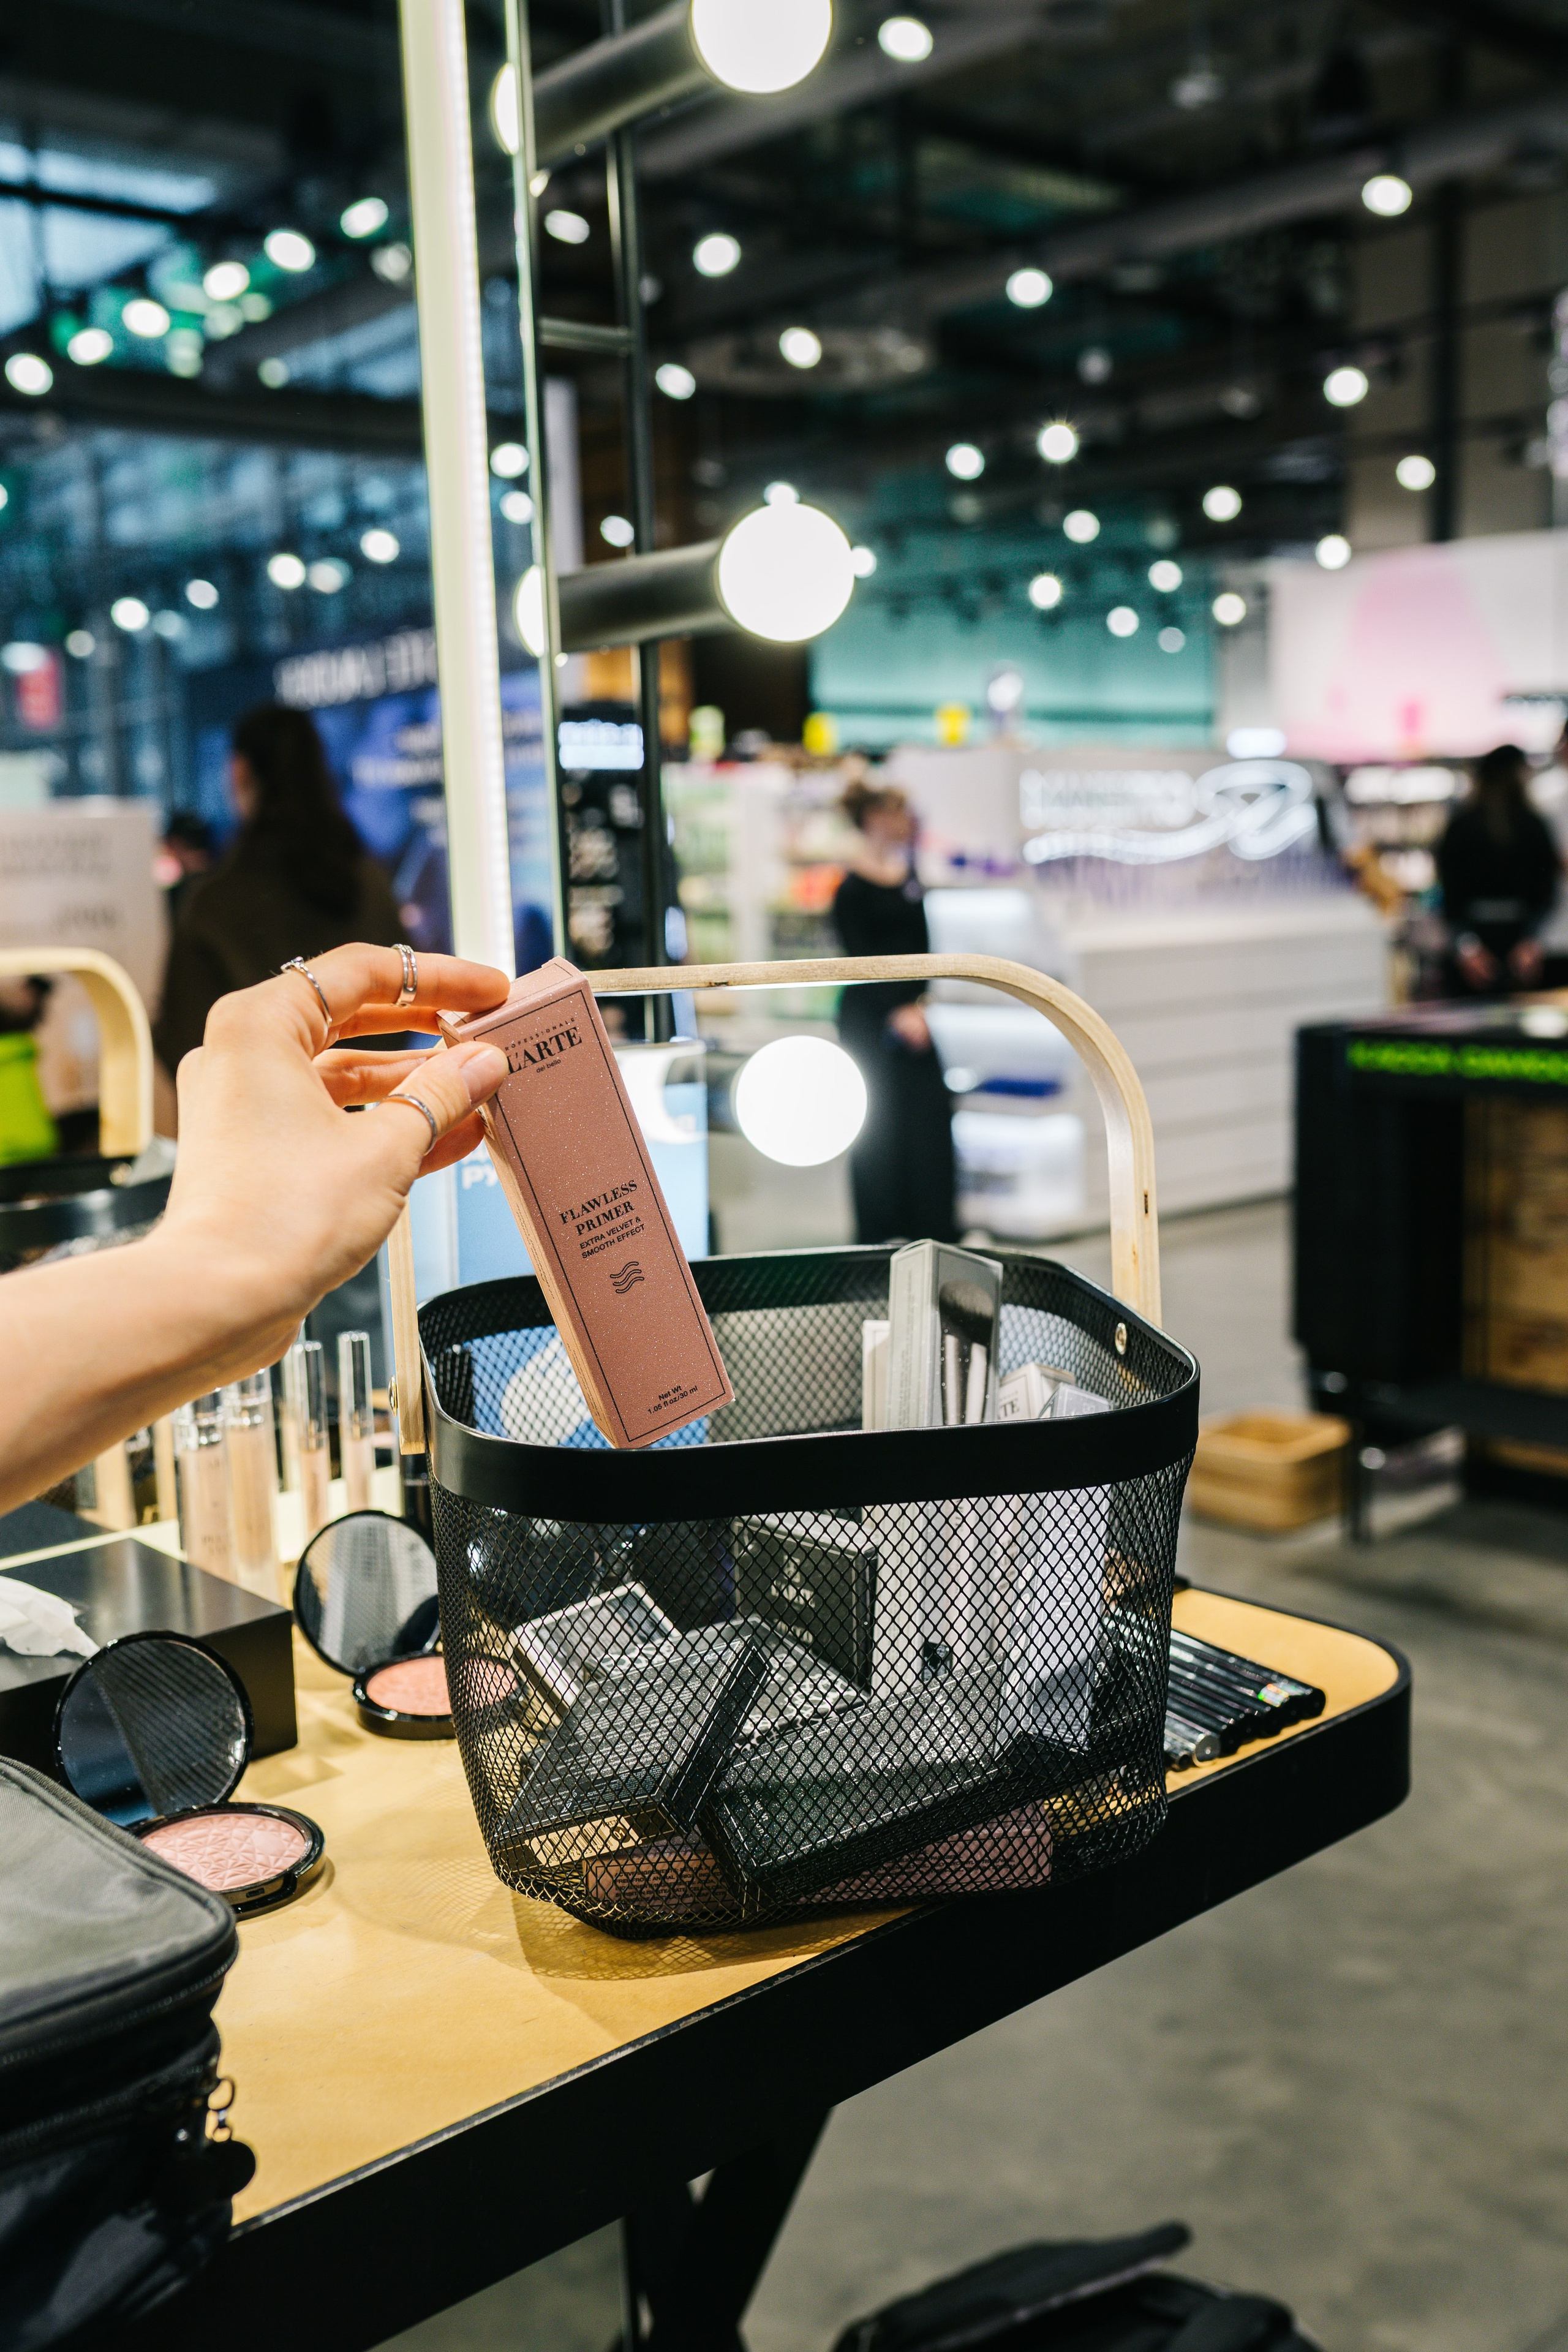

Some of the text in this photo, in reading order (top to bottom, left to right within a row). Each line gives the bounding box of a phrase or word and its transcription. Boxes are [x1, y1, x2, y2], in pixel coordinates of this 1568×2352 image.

[505, 1017, 575, 1051] ROFESSIONALE
[507, 1027, 582, 1075] L'ARTE
[547, 1059, 561, 1069] bello
[559, 1180, 637, 1225] FLAWLESS
[575, 1201, 635, 1236] PRIMER
[580, 1234, 606, 1249] EXTRA
[606, 1219, 633, 1237] VELVET
[582, 1224, 645, 1259] SMOOTH EFFECT
[647, 1404, 663, 1414] 1.05
[669, 1391, 688, 1404] oz/30
[689, 1385, 698, 1394] ml
[658, 1385, 682, 1400] Net Wt
